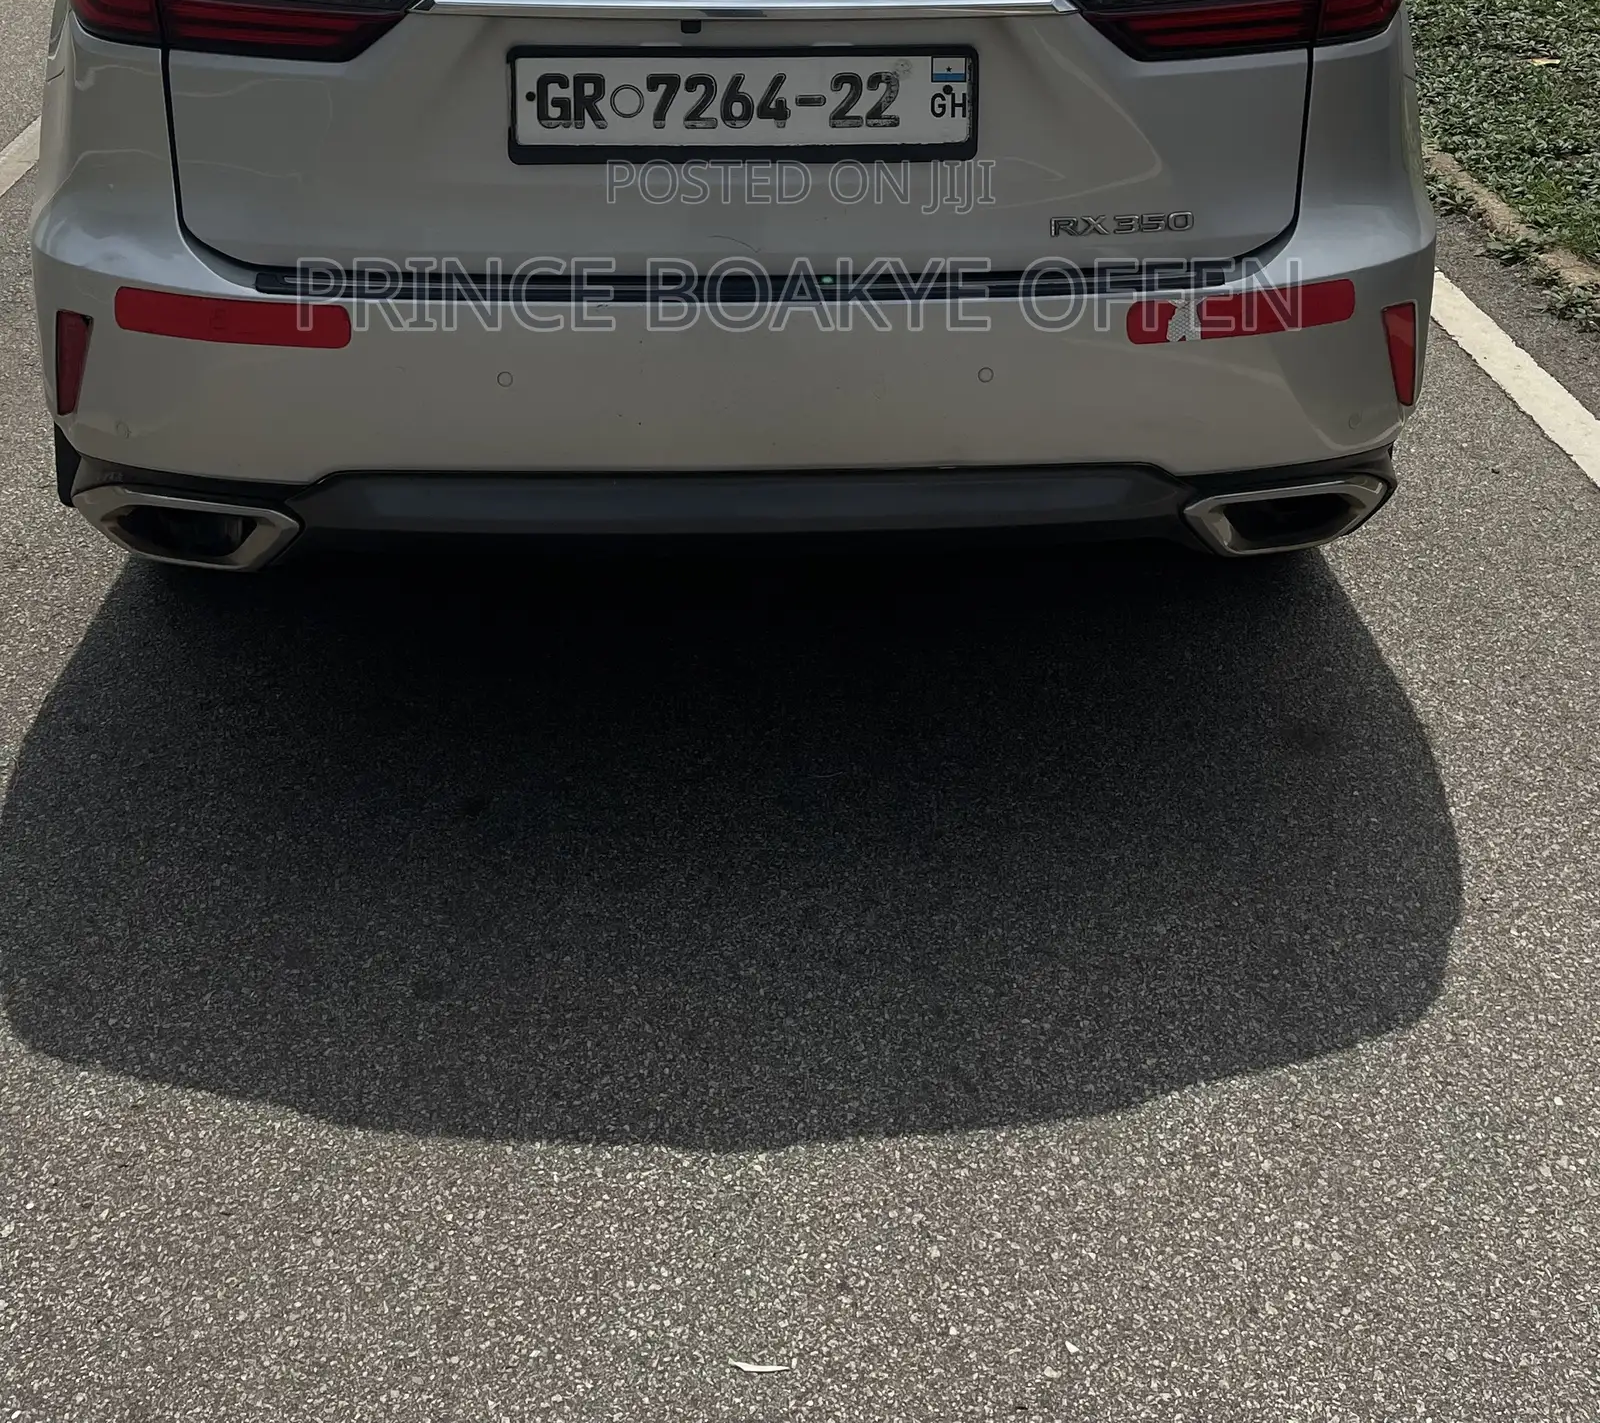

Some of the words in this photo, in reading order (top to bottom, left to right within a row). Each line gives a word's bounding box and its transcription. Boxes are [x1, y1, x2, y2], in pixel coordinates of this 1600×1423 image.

[536, 73, 608, 129] GR
[646, 72, 901, 129] 7264-22
[930, 92, 967, 118] GH
[1050, 215, 1110, 237] RX
[1113, 211, 1194, 234] 350
